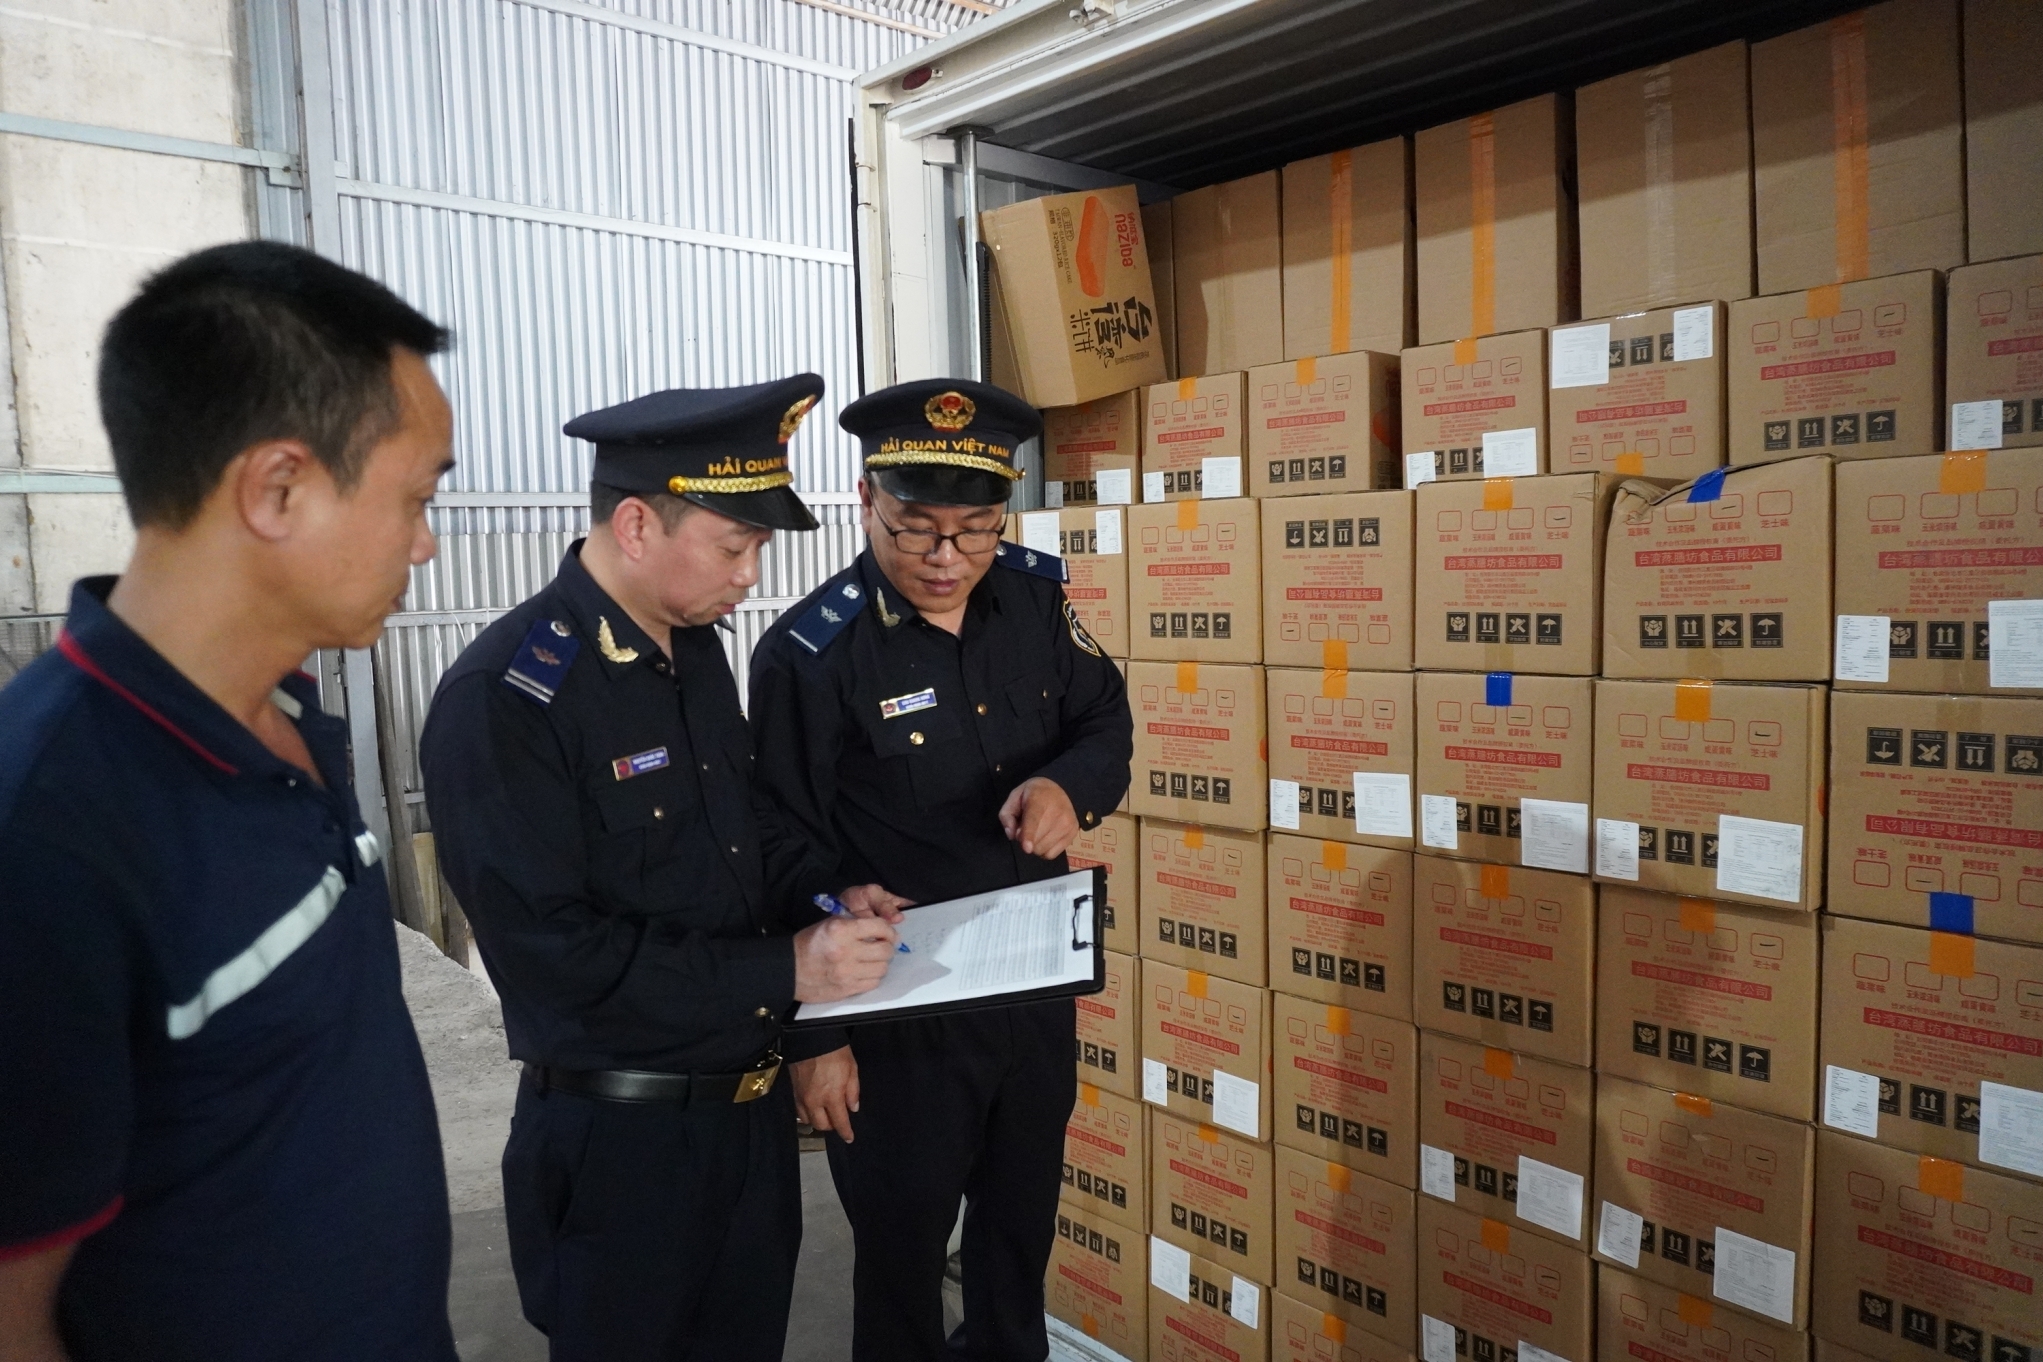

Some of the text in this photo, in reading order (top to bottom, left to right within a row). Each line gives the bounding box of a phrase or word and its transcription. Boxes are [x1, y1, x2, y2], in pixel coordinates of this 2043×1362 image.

[902, 440, 947, 451] QUAN
[989, 445, 1010, 458] NAM
[745, 457, 782, 473] QUAN
[1761, 519, 1789, 528] 芝士味
[2020, 1010, 2043, 1022] 芝士
